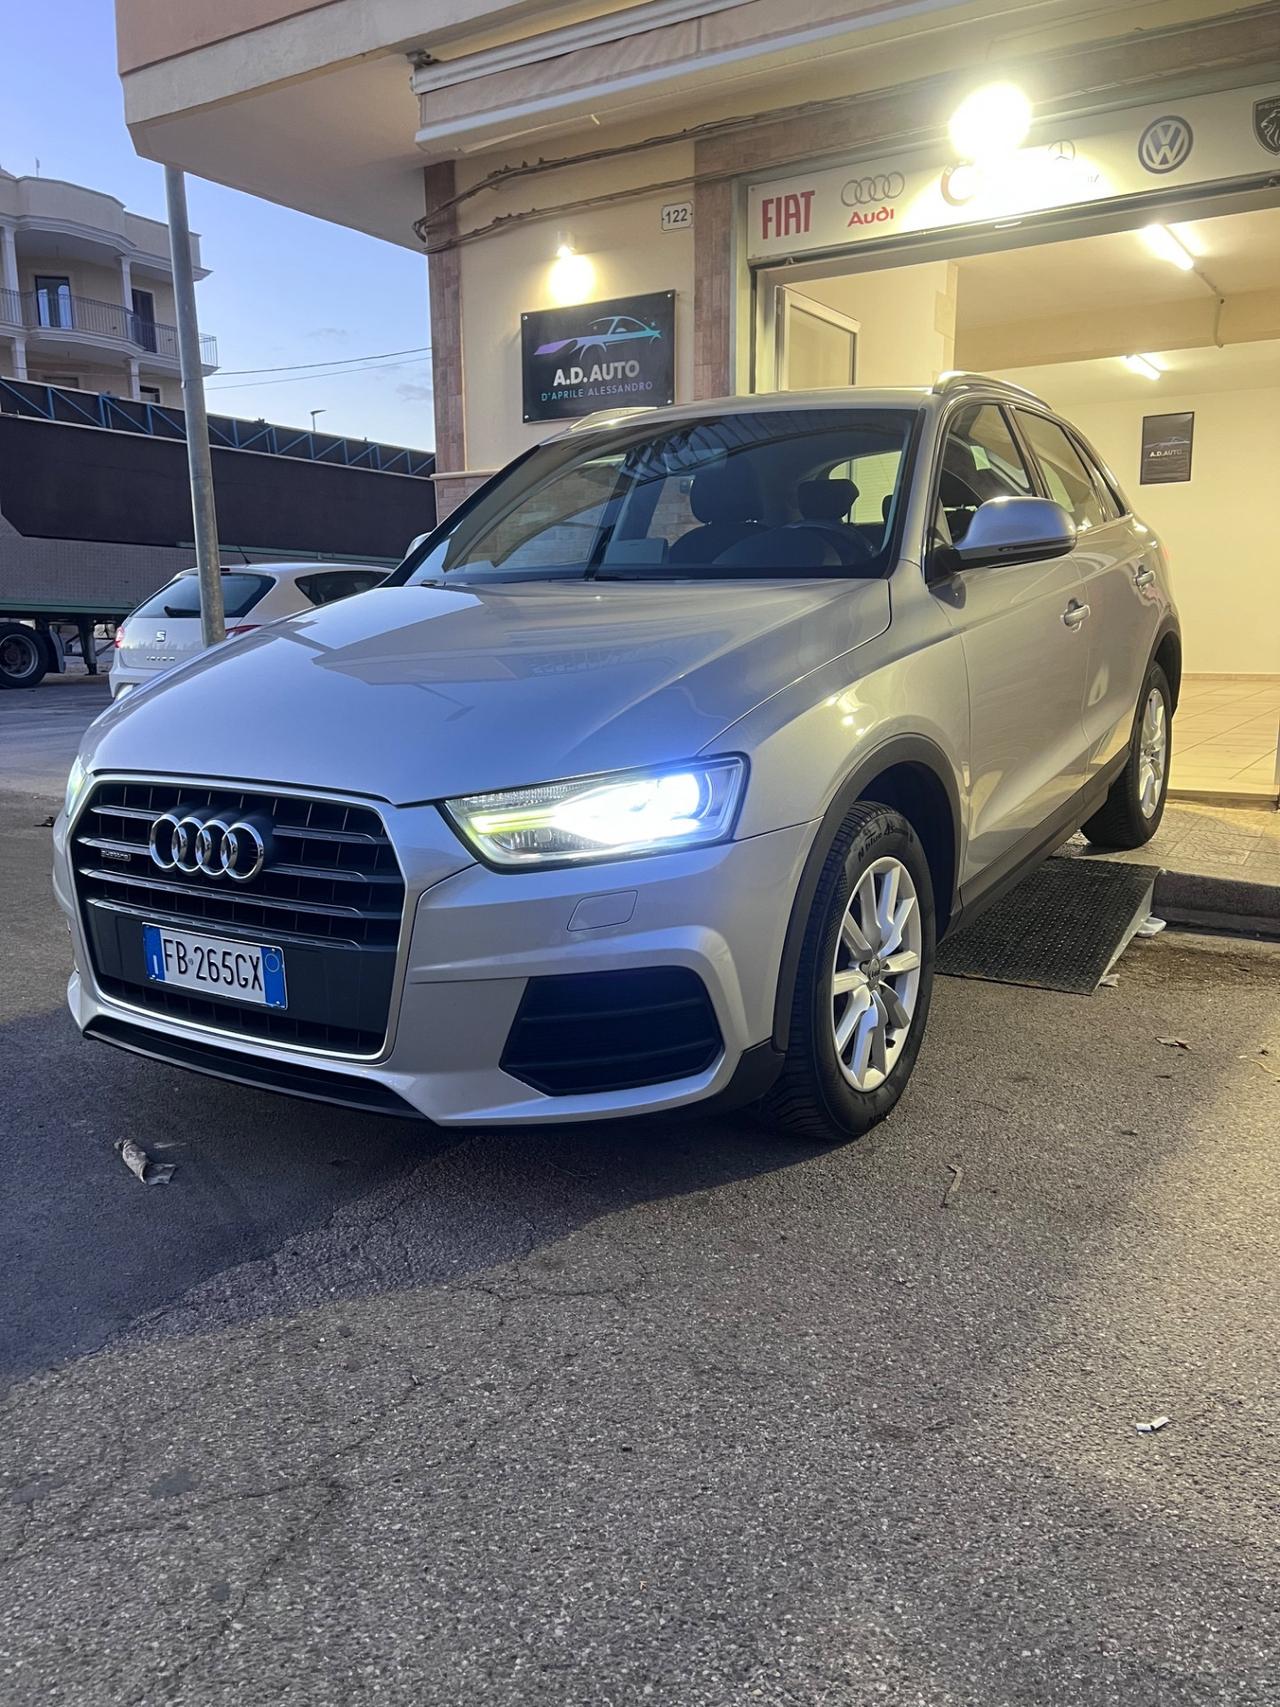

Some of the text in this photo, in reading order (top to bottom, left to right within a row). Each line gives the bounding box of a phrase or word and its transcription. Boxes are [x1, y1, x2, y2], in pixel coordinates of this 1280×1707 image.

[665, 208, 688, 224] 122
[761, 190, 815, 240] FIAT
[847, 206, 894, 227] Audi
[541, 381, 653, 402] D'APRILE ALESSANDRO
